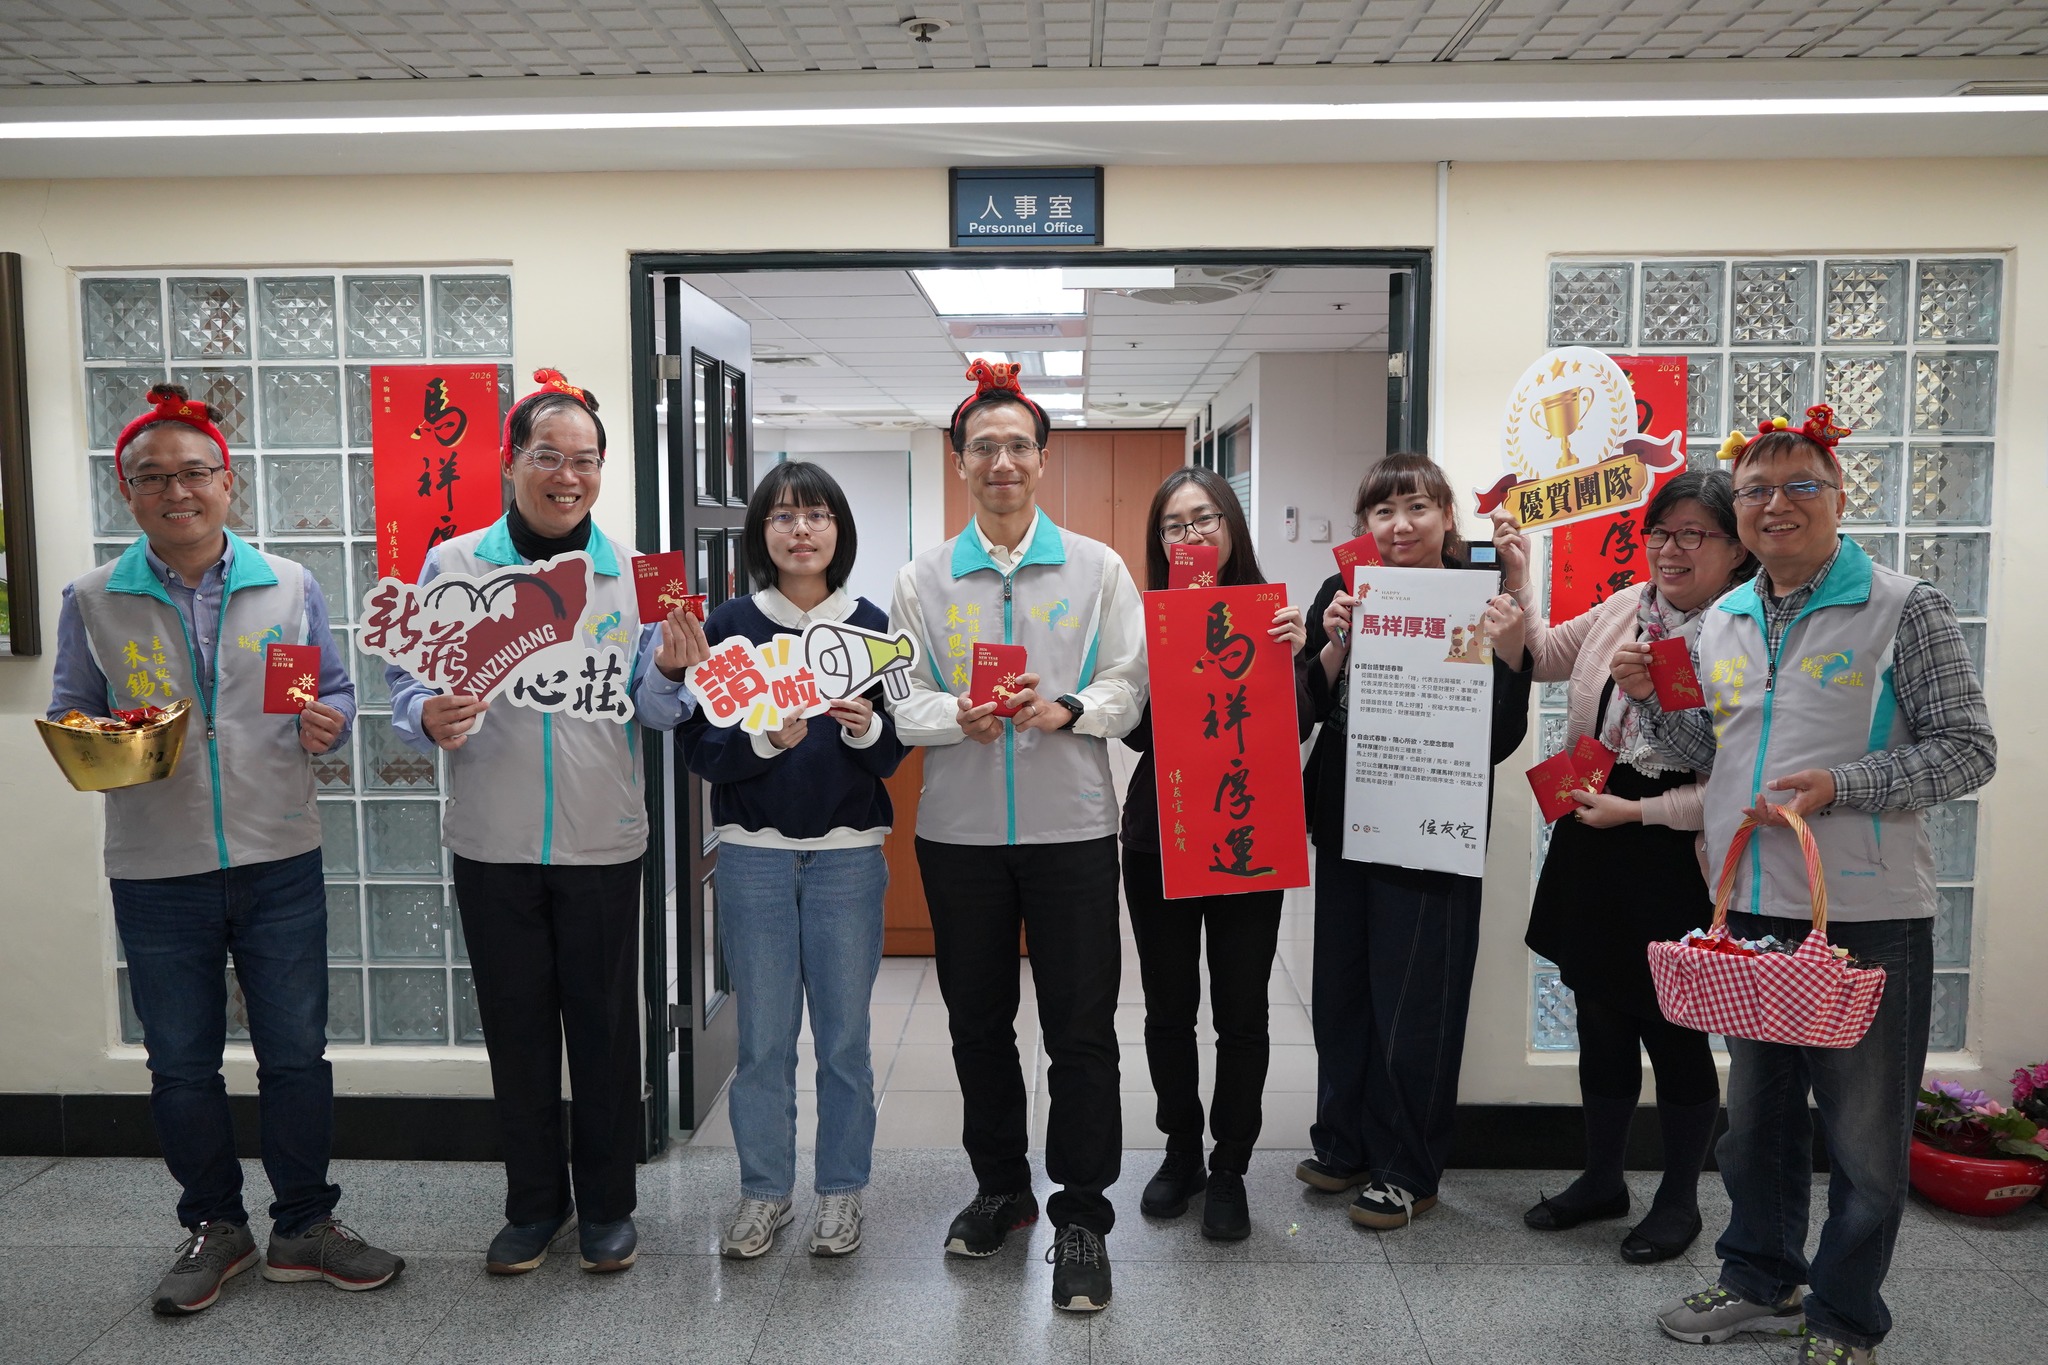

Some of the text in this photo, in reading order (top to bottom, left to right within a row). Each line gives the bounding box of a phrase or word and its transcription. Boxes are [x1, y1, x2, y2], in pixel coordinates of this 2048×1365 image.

[980, 195, 1072, 219] 人事室
[969, 222, 1083, 233] Personnel Office
[470, 372, 491, 380] 2026
[1658, 364, 1680, 372] 2026
[1518, 464, 1633, 525] 優質團隊
[1256, 592, 1280, 602] 2026
[1360, 613, 1447, 640] 馬祥厚運
[151, 635, 173, 697] 主任秘書
[462, 623, 557, 698] XINZHUANG
[1729, 653, 1749, 707] 副區長
[514, 652, 628, 718] 心莊
[694, 644, 822, 719] 讚啦
[1191, 601, 1278, 878] 馬祥厚運
[1419, 819, 1477, 841] 侯友宜
